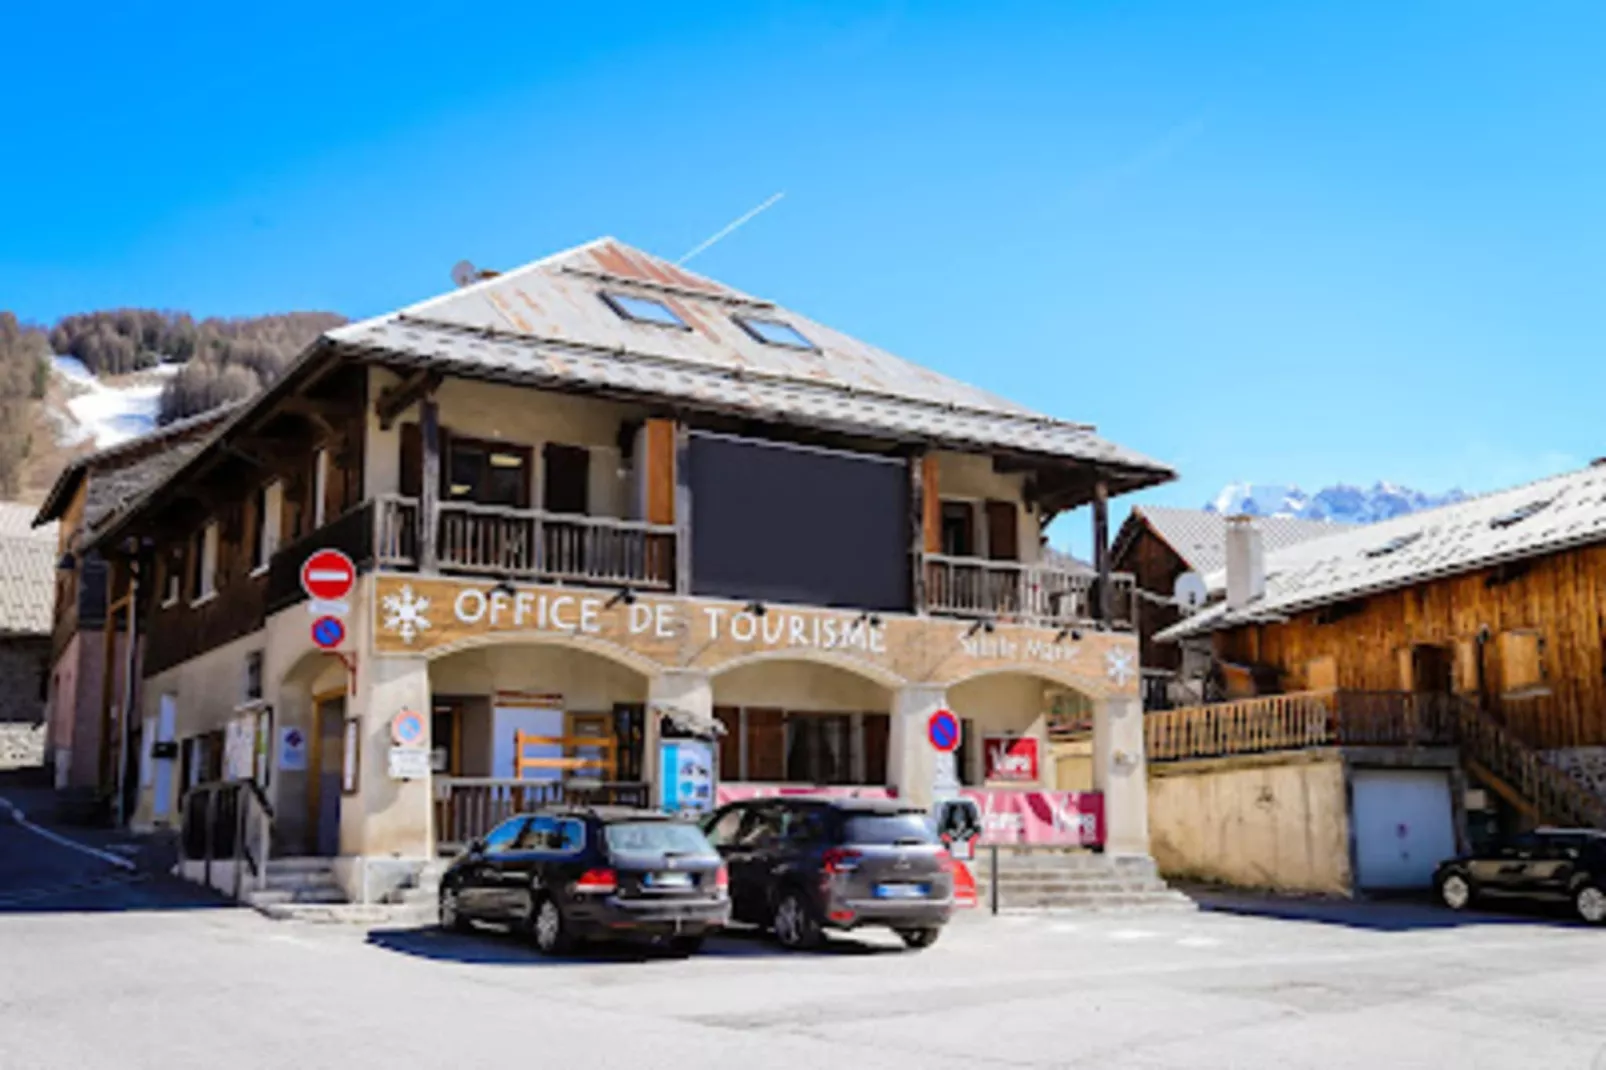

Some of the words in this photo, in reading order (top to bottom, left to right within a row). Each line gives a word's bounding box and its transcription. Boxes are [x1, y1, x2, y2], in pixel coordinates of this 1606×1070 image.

[453, 588, 599, 633] OFFICE
[629, 602, 675, 638] DE
[704, 606, 887, 653] TOURISME
